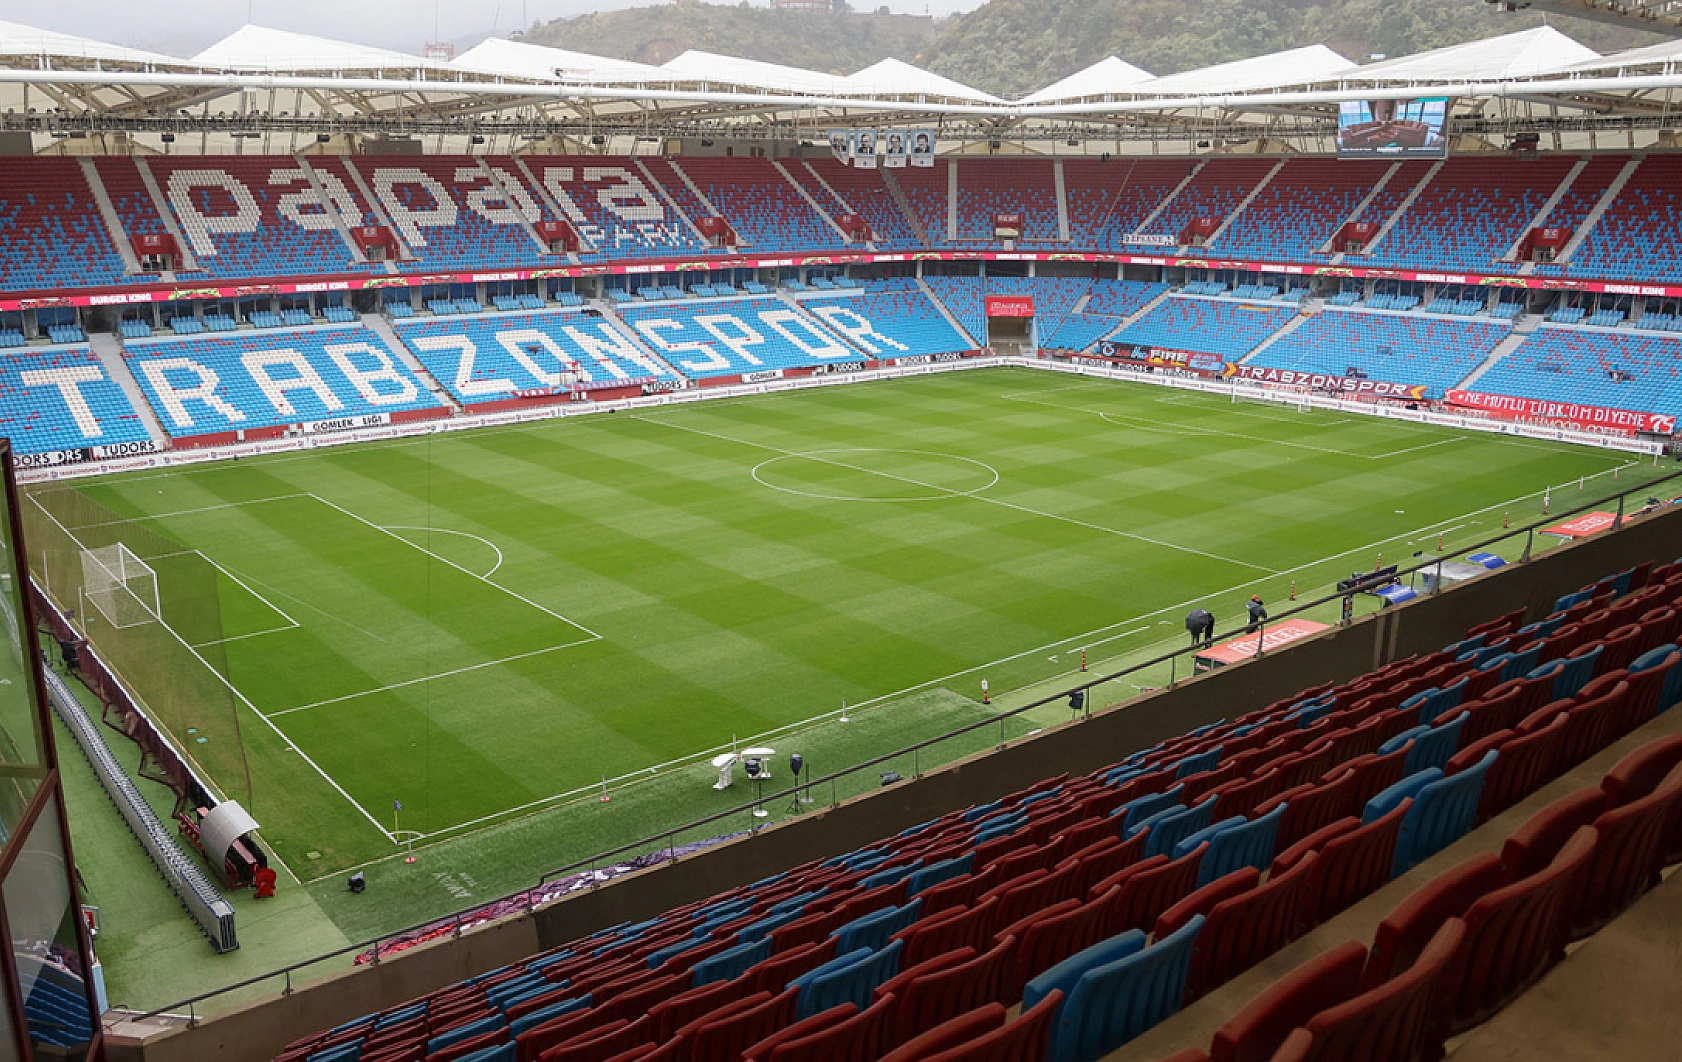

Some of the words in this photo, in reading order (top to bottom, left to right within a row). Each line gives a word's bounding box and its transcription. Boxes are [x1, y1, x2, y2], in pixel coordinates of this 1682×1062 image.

[167, 167, 664, 257] papara
[89, 295, 128, 305] BURGER
[1150, 349, 1188, 362] FIRE
[20, 306, 909, 438] TRABZONSPOR
[1238, 366, 1408, 396] TRABZONSPOR
[1465, 392, 1483, 404] NE
[1484, 393, 1527, 410] MUTLU
[101, 441, 155, 456] TUDORS
[13, 453, 51, 467] DORS
